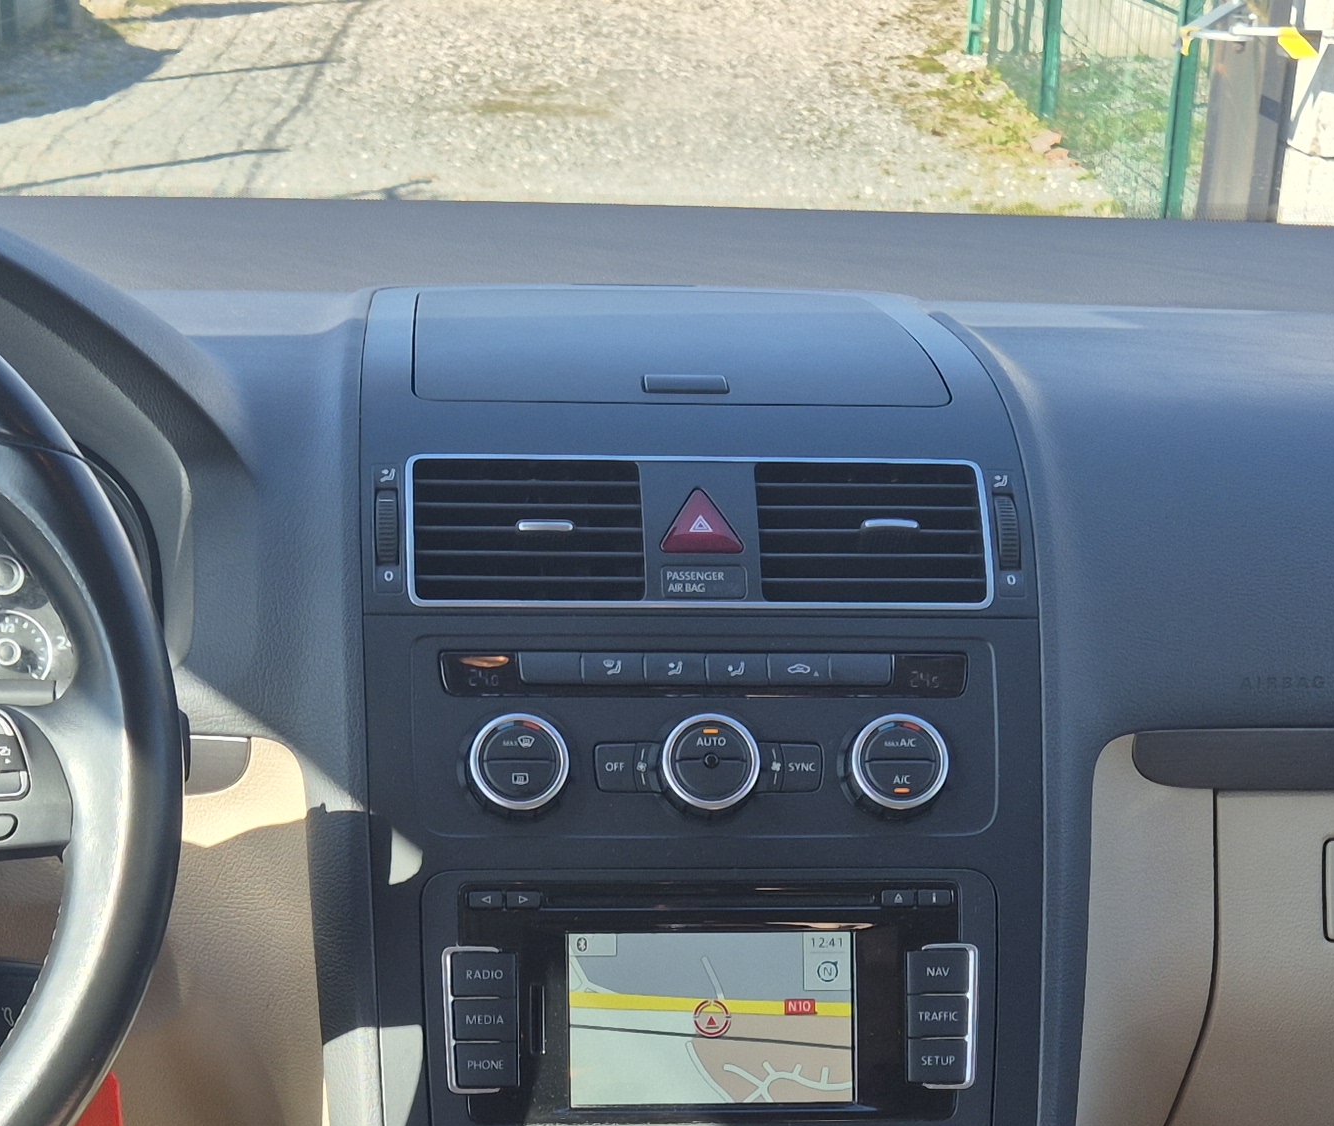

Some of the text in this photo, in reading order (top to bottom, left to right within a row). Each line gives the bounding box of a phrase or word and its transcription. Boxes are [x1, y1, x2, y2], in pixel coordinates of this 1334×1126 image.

[666, 571, 725, 581] PASSENGER
[667, 582, 706, 592] AIR BAG
[1239, 675, 1326, 690] AIRBAG
[695, 736, 727, 748] AUTO
[899, 737, 917, 748] A/C
[604, 761, 625, 772] OFF
[787, 761, 816, 772] SYNC
[892, 774, 911, 785] A/C
[465, 969, 504, 980] RADIO
[925, 966, 950, 977] NAV
[787, 1001, 811, 1013] N10
[465, 1014, 504, 1025] MEDIA
[917, 1010, 959, 1022] TRAFFIC
[466, 1059, 504, 1070] PHONE
[920, 1054, 956, 1067] SETUP
